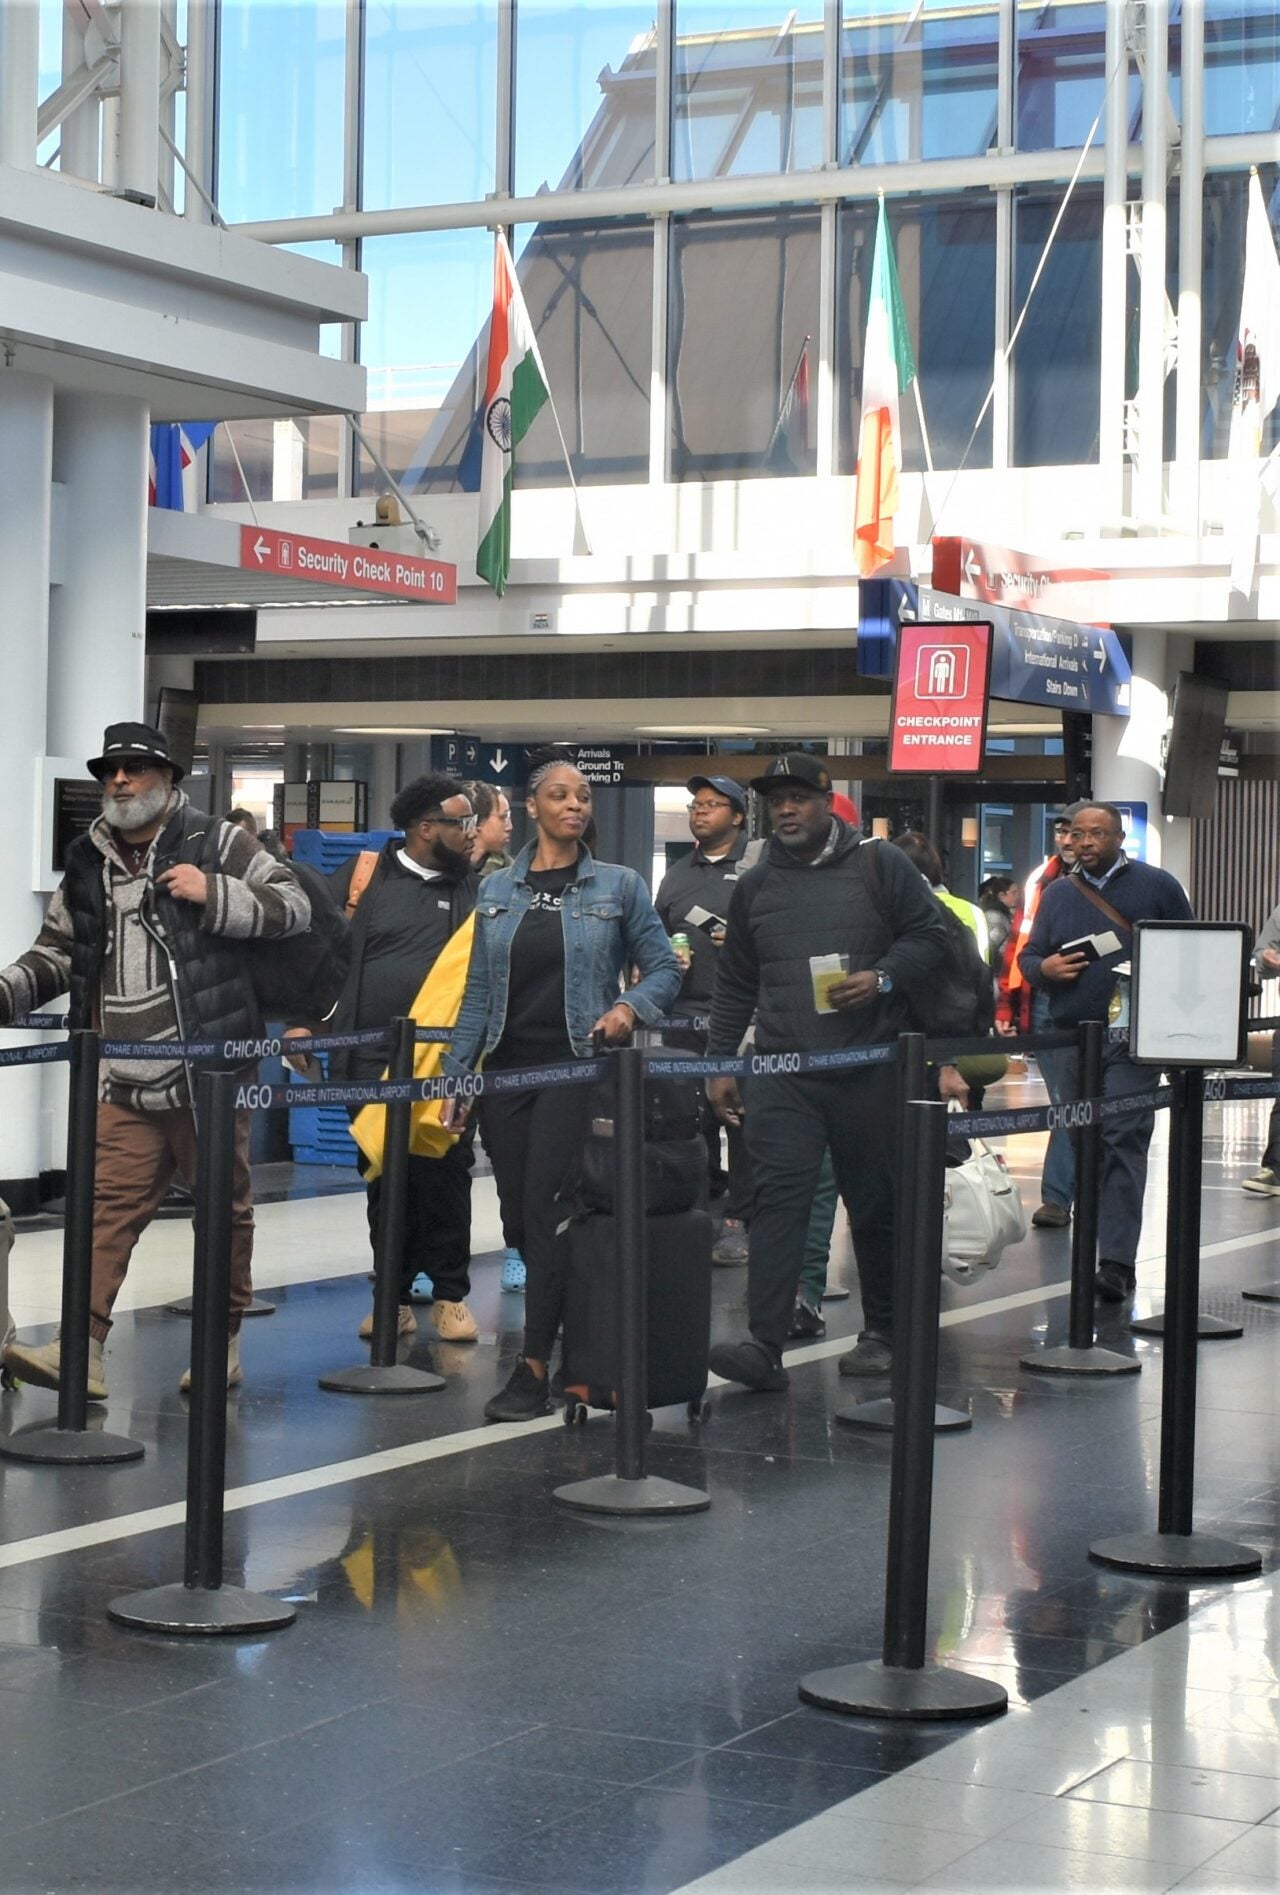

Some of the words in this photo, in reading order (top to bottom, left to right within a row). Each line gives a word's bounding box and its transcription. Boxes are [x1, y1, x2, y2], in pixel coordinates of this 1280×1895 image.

[298, 546, 348, 580] Security
[353, 557, 391, 583] Check
[396, 567, 425, 588] Point
[430, 572, 443, 591] 10
[1000, 567, 1038, 599] Security
[1024, 649, 1058, 669] International
[1058, 655, 1078, 673] Arrivals
[1046, 678, 1062, 695] Stairs
[1063, 681, 1078, 697] Down
[897, 716, 982, 727] CHECKPOINT
[902, 734, 972, 745] ENTRANCE
[448, 743, 456, 760] P
[577, 748, 611, 758] Arrivals
[576, 761, 611, 770] Ground
[581, 772, 611, 784] arking
[612, 772, 621, 782] D
[694, 1016, 710, 1030] CHIC
[24, 1046, 58, 1059] AIRPORT
[132, 1043, 186, 1056] INTERNATIONAL
[187, 1044, 216, 1056] AIRPORT
[223, 1038, 281, 1059] CHICAGO
[313, 1034, 359, 1049] INTERNATIONAL
[360, 1031, 385, 1043] AIRPORT
[673, 1061, 720, 1073] INTERNATIONAL
[720, 1060, 744, 1072] AIRPORT
[751, 1053, 800, 1074] CHICAGO
[829, 1050, 869, 1065] INTERNATIONAL
[869, 1047, 890, 1059] AIRPORT
[286, 1088, 317, 1103] O'HARE
[318, 1086, 379, 1102] INTERNATIONAL
[379, 1084, 412, 1098] AIRPORT
[421, 1074, 484, 1100] CHICAGO
[520, 1068, 571, 1086] INTERNATIONAL
[571, 1064, 598, 1078] AIRPORT
[971, 1115, 1017, 1134] INTERNATIONAL
[1017, 1113, 1040, 1128] AIRPORT
[1046, 1101, 1093, 1130] CHICAGO
